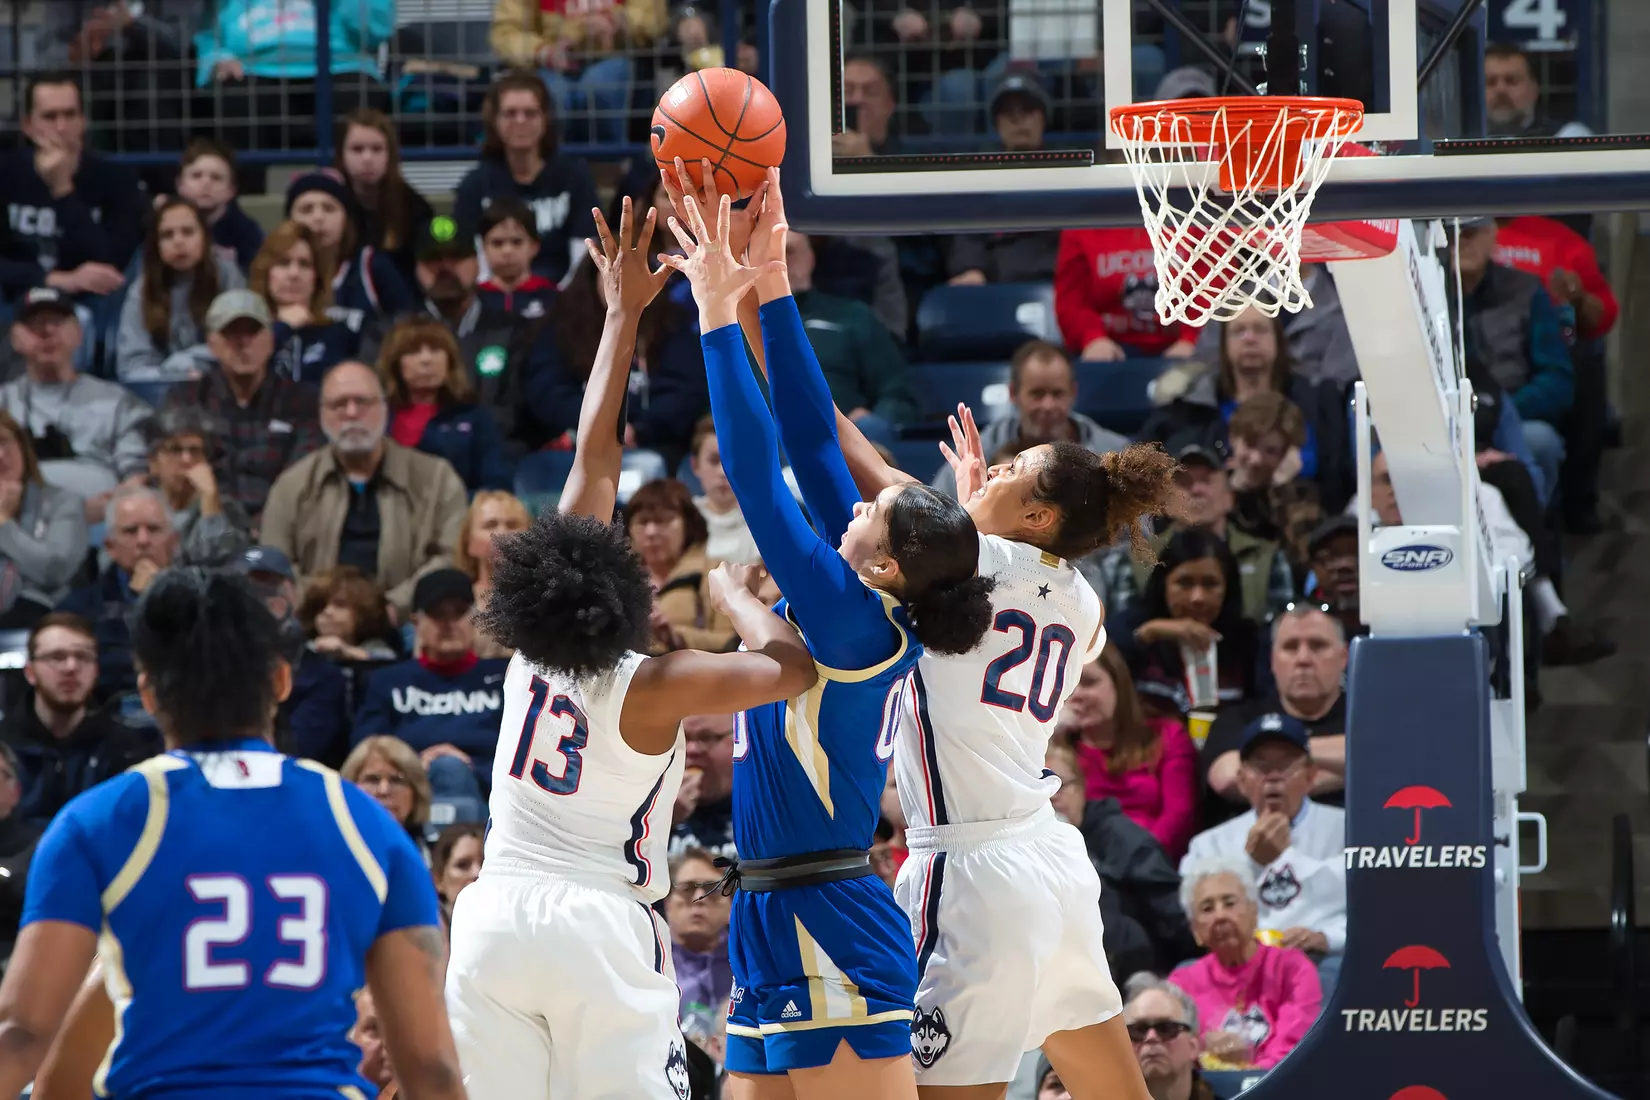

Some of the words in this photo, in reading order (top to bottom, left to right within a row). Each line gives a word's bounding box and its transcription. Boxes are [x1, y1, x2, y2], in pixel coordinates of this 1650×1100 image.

[1503, 0, 1567, 39] 4
[980, 608, 1076, 723] 20
[391, 685, 501, 716] UCONN
[509, 675, 589, 796] 13
[1343, 845, 1487, 869] TRAVELERS
[181, 871, 330, 993] 23
[780, 1010, 802, 1019] adidas
[1340, 1008, 1489, 1032] TRAVELERS
